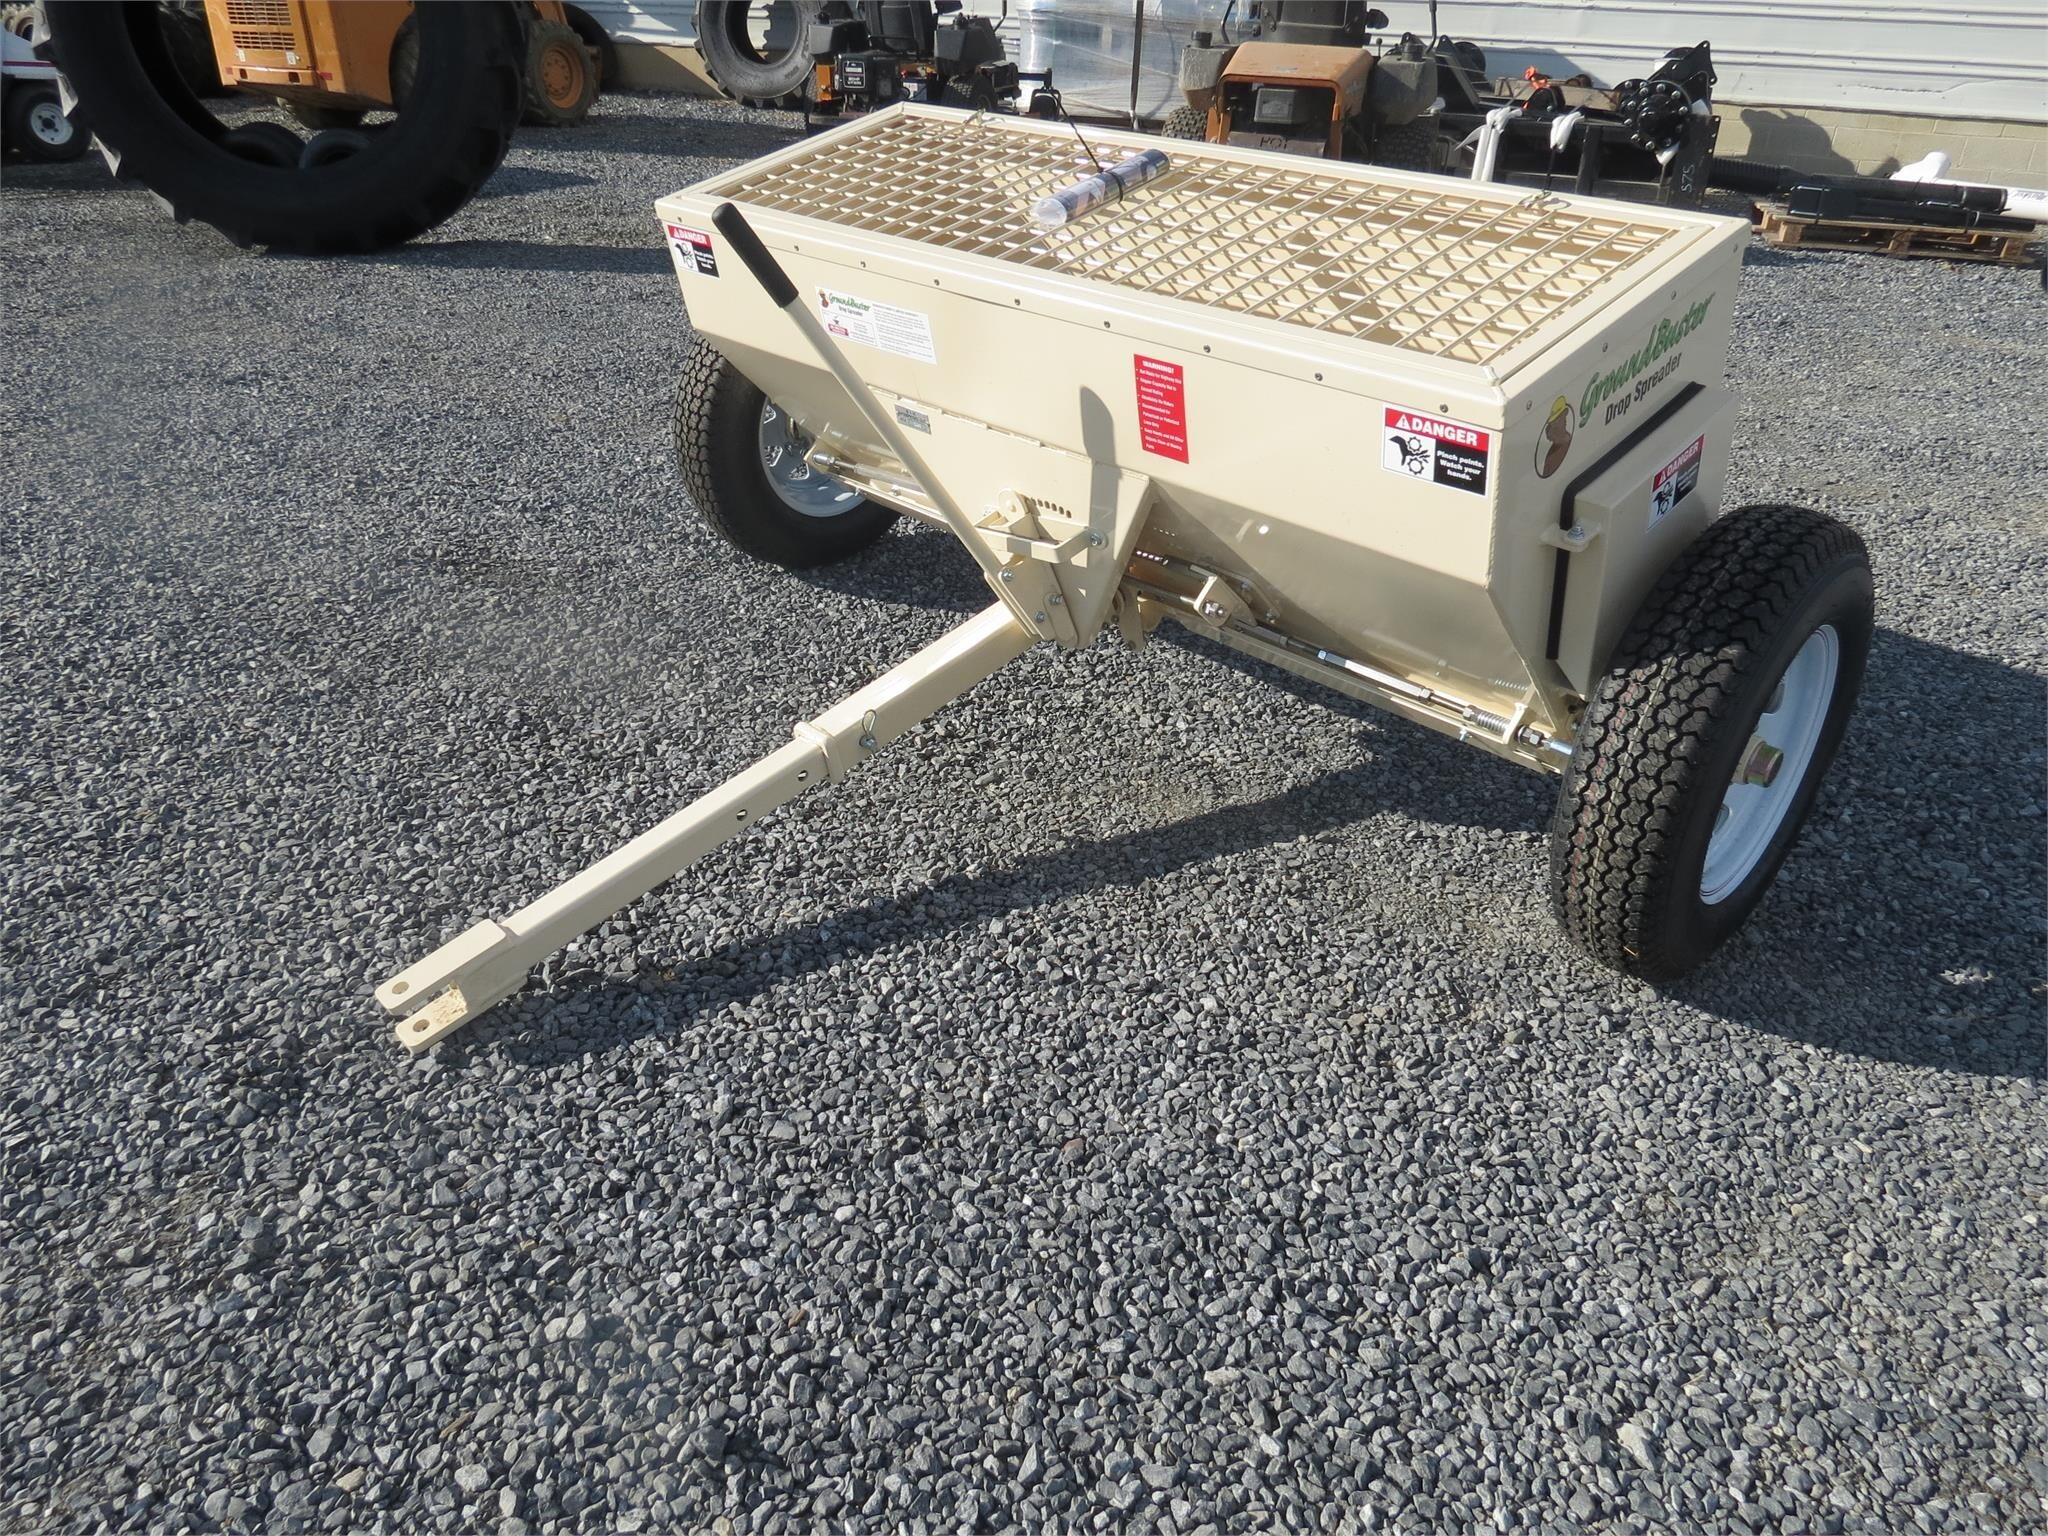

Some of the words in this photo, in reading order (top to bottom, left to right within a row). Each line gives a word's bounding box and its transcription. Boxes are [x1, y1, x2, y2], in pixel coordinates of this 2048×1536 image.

[1142, 360, 1174, 374] WARNING!
[1579, 292, 1716, 428] GroundBuster
[1605, 393, 1631, 426] Drop
[1634, 352, 1682, 402] Spreader
[1412, 417, 1477, 447] DANGER
[1437, 450, 1458, 461] Pinch
[1459, 457, 1485, 469] points.
[1440, 459, 1463, 471] Watch
[1464, 466, 1481, 475] your
[1667, 440, 1699, 477] DANGER
[1447, 469, 1472, 481] hands.
